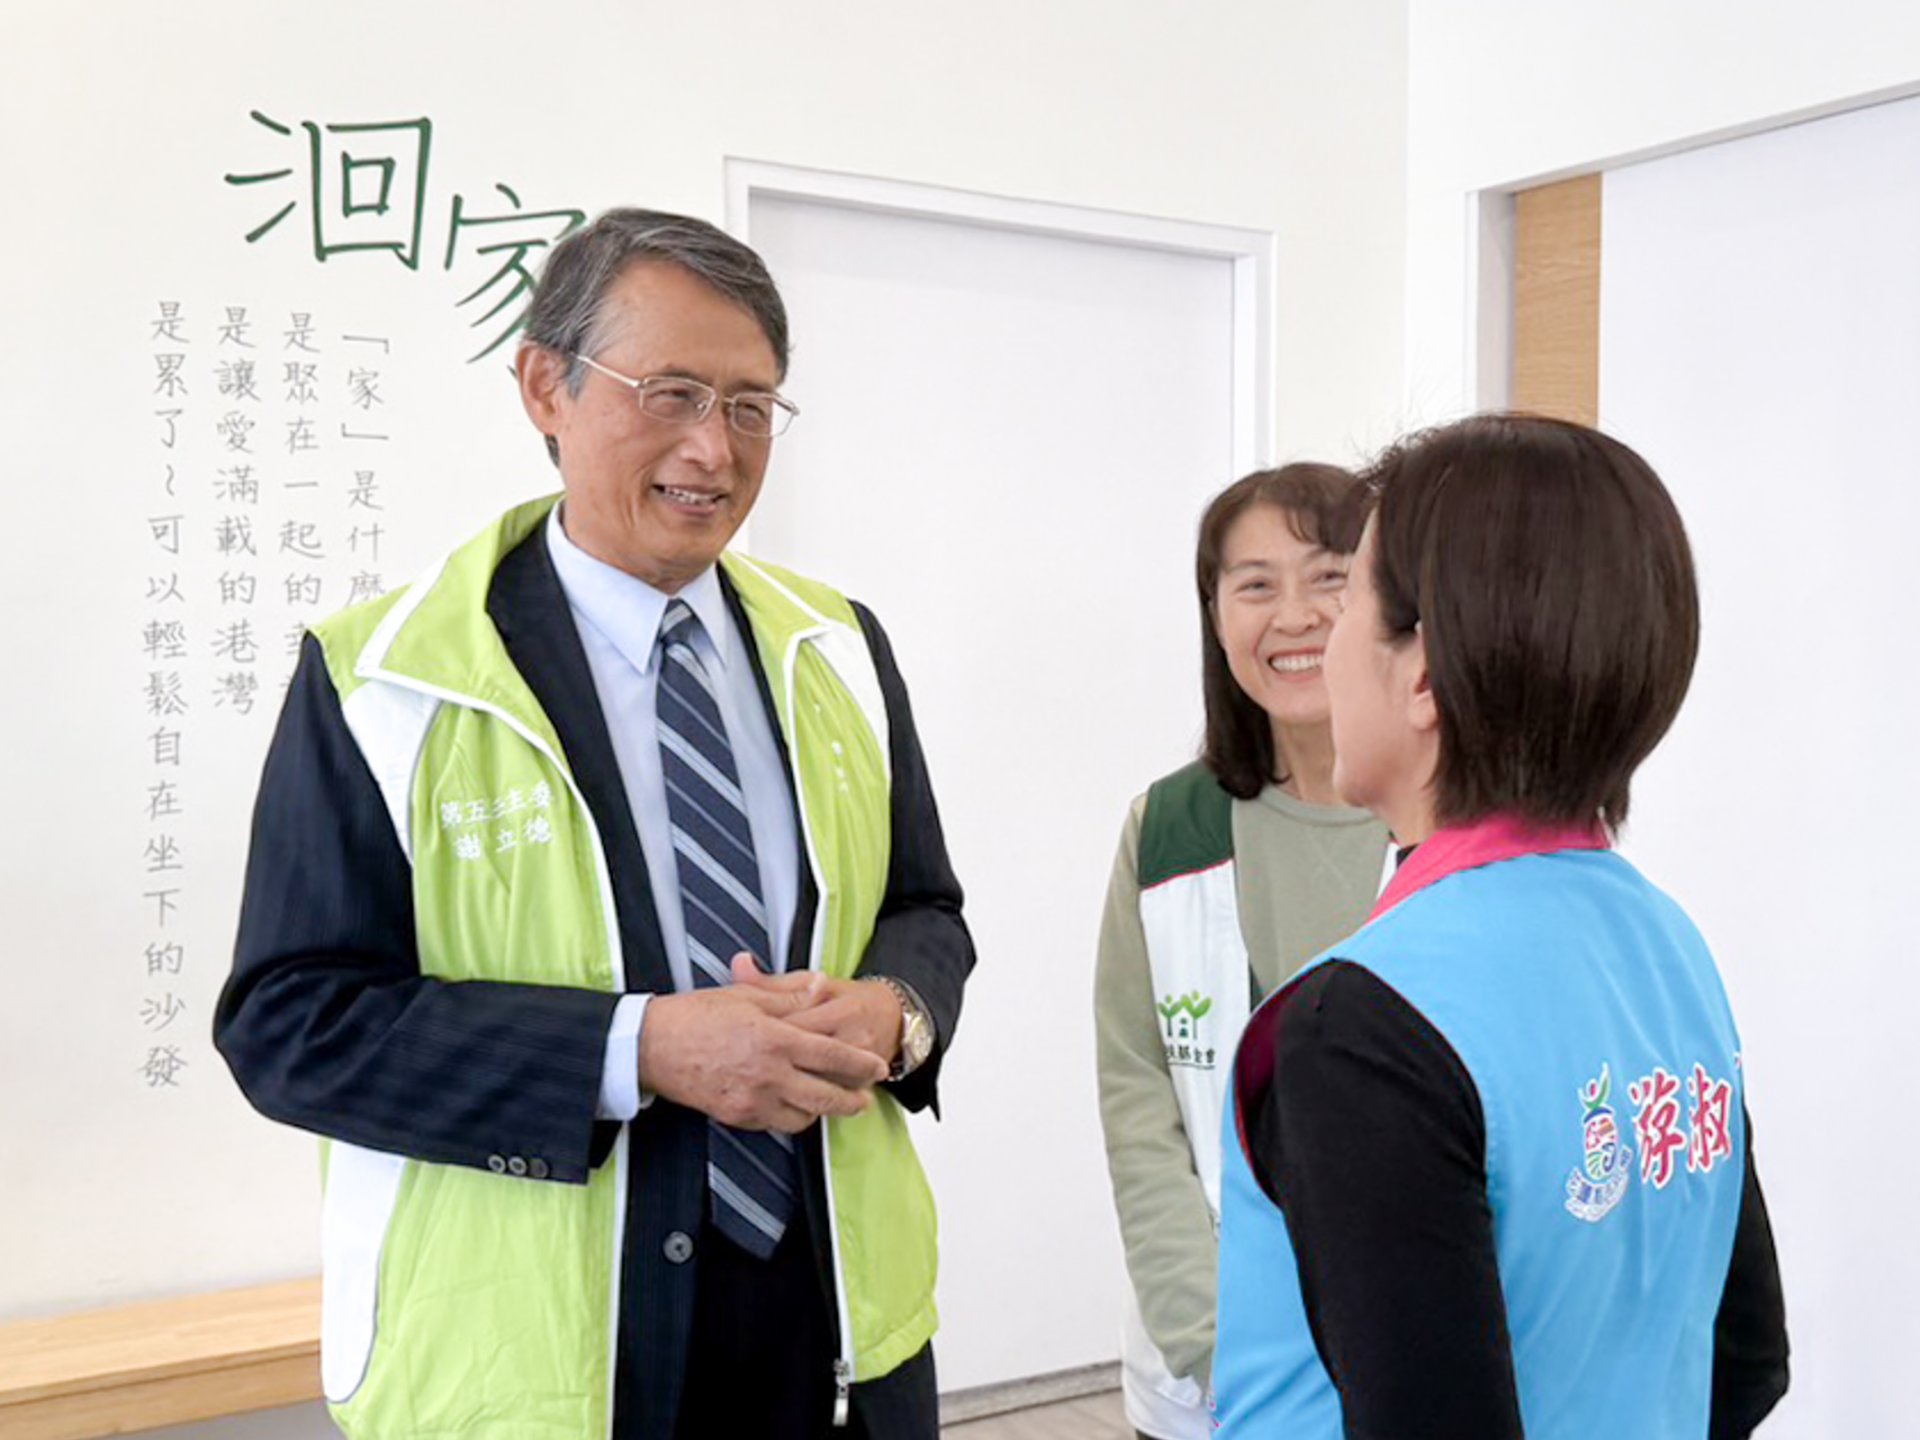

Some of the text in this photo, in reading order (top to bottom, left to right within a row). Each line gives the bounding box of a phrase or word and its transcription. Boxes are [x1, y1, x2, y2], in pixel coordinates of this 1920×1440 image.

[223, 110, 586, 378] 洄家
[211, 305, 262, 716] 是讓愛滿載的港灣
[1628, 1052, 1741, 1188] 游淑
